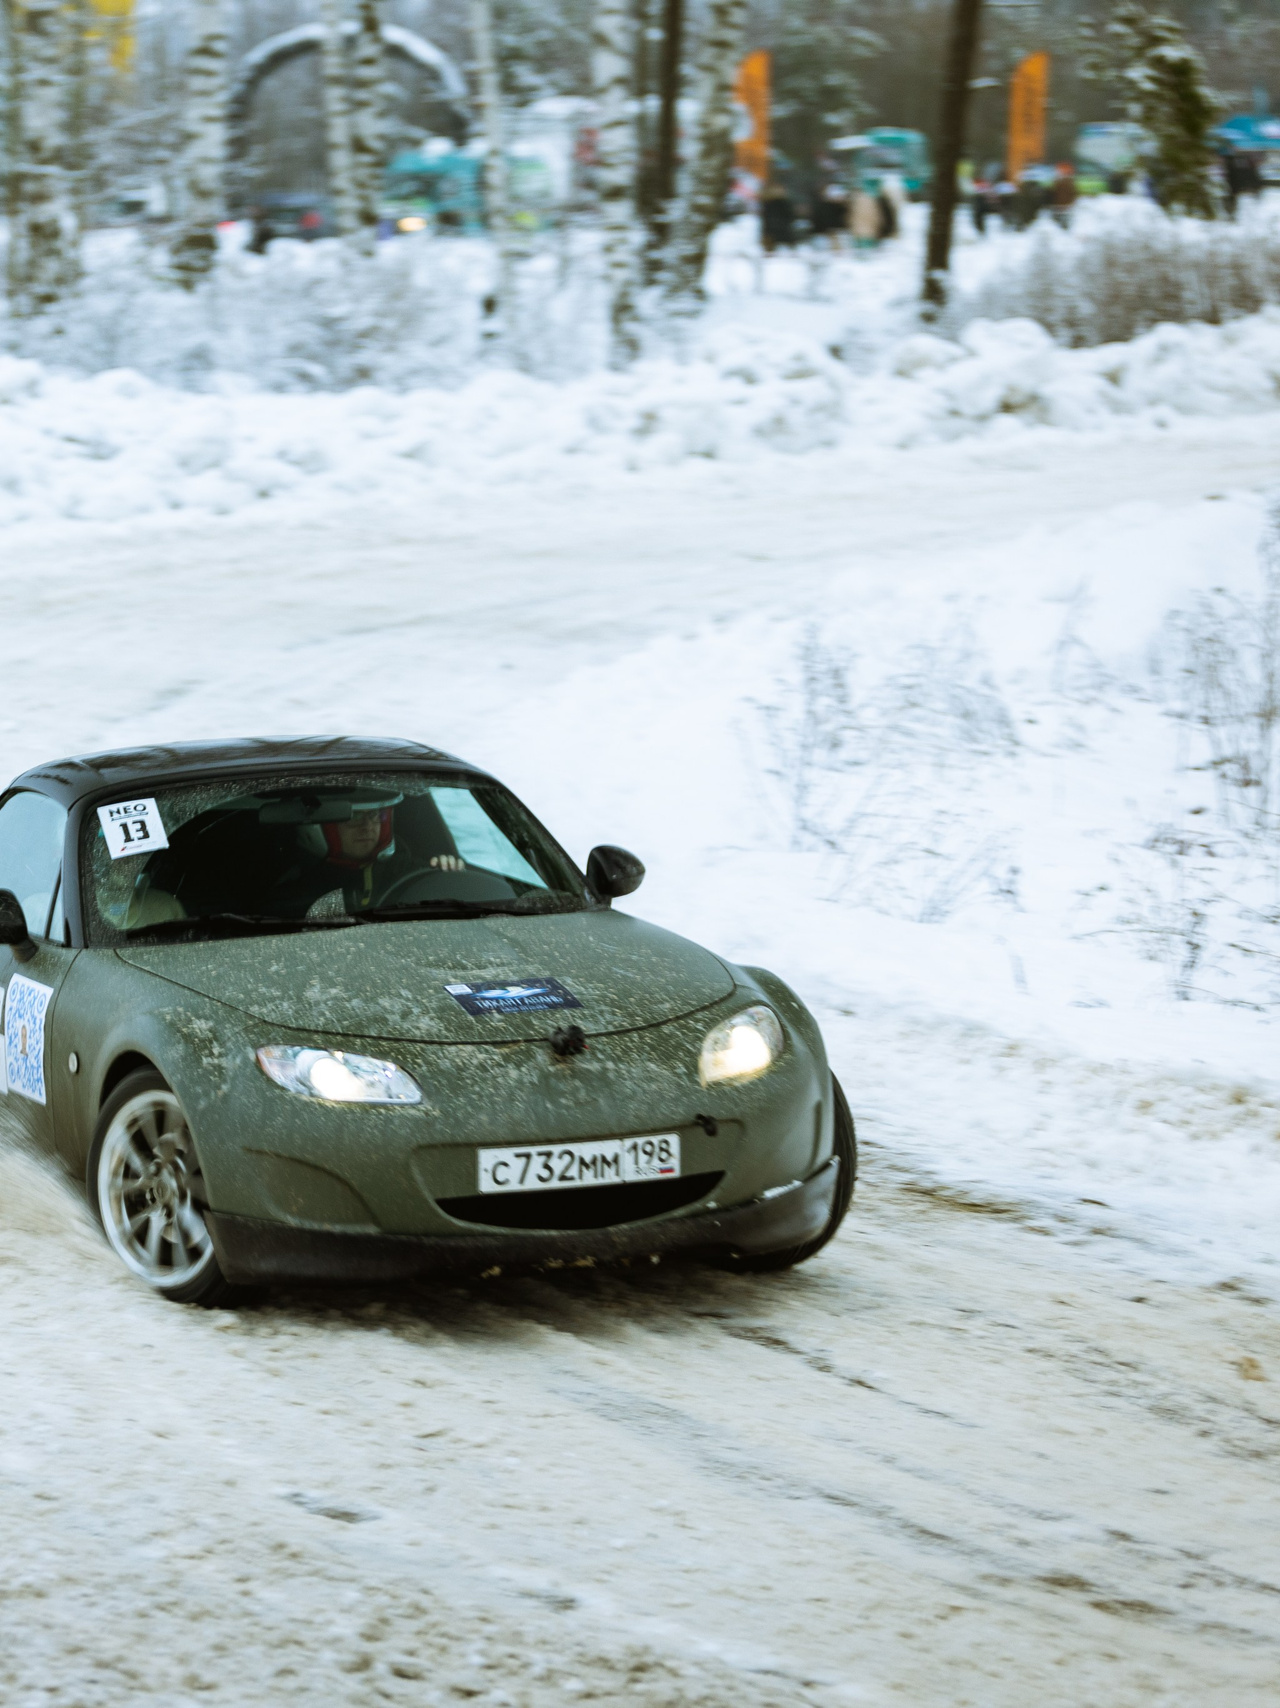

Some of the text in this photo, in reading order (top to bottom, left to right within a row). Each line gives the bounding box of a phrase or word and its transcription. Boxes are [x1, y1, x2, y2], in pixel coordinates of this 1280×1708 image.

[108, 803, 147, 817] NEO
[119, 819, 150, 844] 13
[627, 1138, 672, 1167] 198
